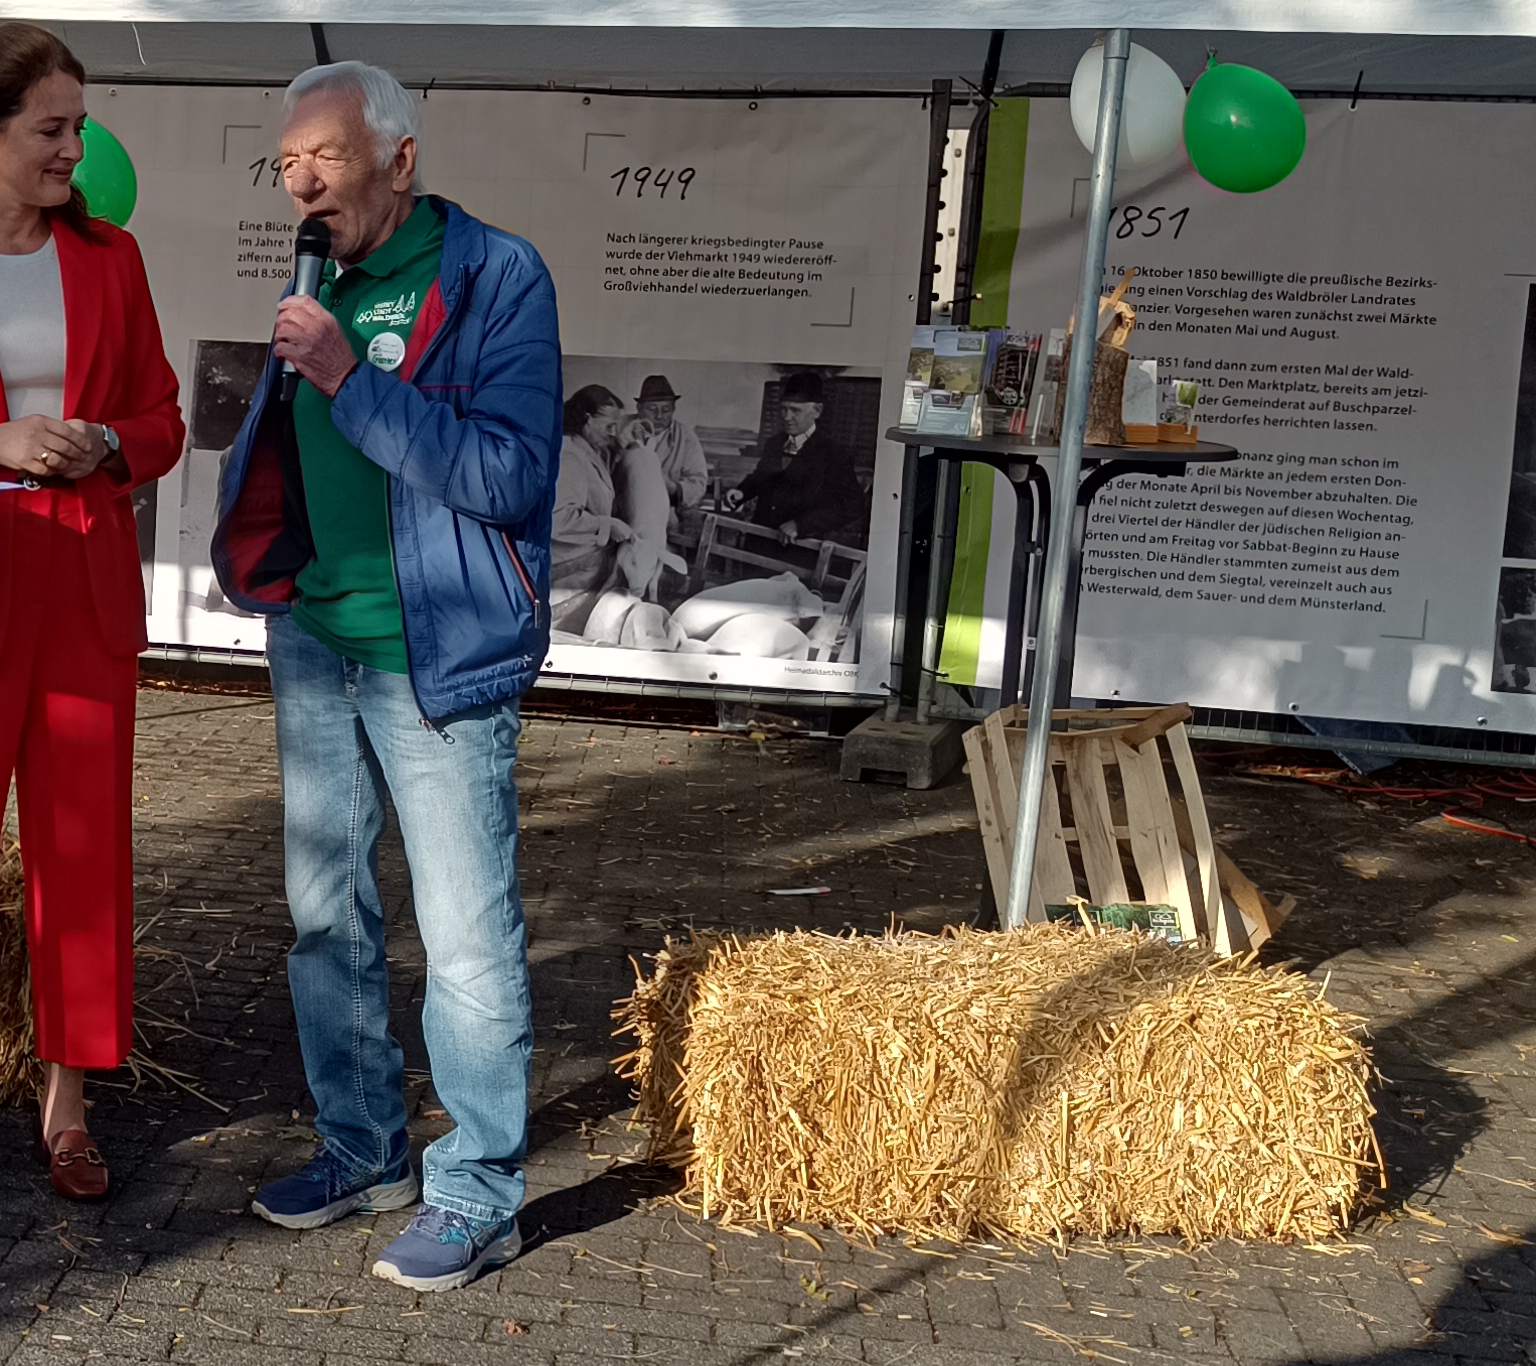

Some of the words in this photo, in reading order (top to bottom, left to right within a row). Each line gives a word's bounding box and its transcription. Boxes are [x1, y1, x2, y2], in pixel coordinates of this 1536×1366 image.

[610, 166, 696, 201] 1949
[238, 221, 263, 232] Eine
[265, 221, 295, 233] Blüte
[254, 236, 285, 248] Jahre
[606, 233, 636, 244] Nach
[638, 233, 689, 248] längerer
[690, 235, 786, 251] kriegsbedingter
[788, 238, 824, 250] Pause
[236, 251, 273, 263] ziffern
[274, 253, 294, 263] auf
[606, 249, 643, 261] wurde
[644, 249, 665, 261] der
[668, 250, 729, 263] Viehmarkt
[732, 252, 761, 264] 1949
[764, 253, 837, 266] wiedereröff-
[236, 267, 259, 278] und
[260, 267, 292, 279] 8.500
[604, 265, 627, 277] net,
[630, 264, 660, 276] ohne
[662, 266, 690, 277] aber
[692, 266, 711, 278] die
[712, 267, 736, 279] alte
[738, 268, 805, 284] Bedeutung
[1188, 268, 1218, 280] 1850
[1220, 269, 1284, 285] bewilligte
[1286, 272, 1307, 284] die
[1310, 274, 1383, 287] preußische
[1386, 276, 1438, 289] Bezirks-
[604, 280, 699, 294] Großviehhandel
[700, 283, 813, 300] wiederzuerlangen.
[1148, 285, 1183, 297] einen
[1186, 286, 1248, 302] Vorschlag
[1251, 288, 1273, 300] des
[1276, 290, 1348, 304] Waldbröler
[1351, 293, 1416, 306] Landrates
[1174, 304, 1249, 318] Vorgesehen
[1252, 309, 1292, 319] waren
[1294, 310, 1353, 322] zunächst
[1356, 312, 1386, 323] zwei
[1390, 313, 1437, 326] Märkte
[1148, 320, 1172, 332] den
[1176, 322, 1232, 335] Monaten
[1234, 324, 1258, 336] Mai
[1261, 326, 1287, 337] und
[1290, 327, 1340, 342] August.
[1184, 357, 1212, 370] fand
[1214, 359, 1247, 371] dann
[1250, 363, 1277, 373] zum
[1280, 364, 1321, 375] ersten
[1324, 365, 1348, 376] Mal
[1352, 366, 1374, 378] der
[1376, 367, 1414, 380] Wald-
[1218, 377, 1243, 389] Den
[1247, 379, 1320, 395] Marktplatz,
[1324, 382, 1368, 395] bereits
[1394, 386, 1428, 400] jetzi-
[1198, 393, 1219, 405] der
[1222, 395, 1305, 410] Gemeinderat
[1308, 400, 1331, 411] auf
[1332, 401, 1417, 417] Buschparzel-
[1264, 415, 1330, 429] herrichten
[1334, 419, 1378, 432] lassen.
[1276, 453, 1305, 467] ging
[1308, 456, 1337, 466] man
[1341, 456, 1379, 468] schon
[1197, 465, 1217, 477] die
[1219, 466, 1265, 480] Märkte
[1286, 470, 1327, 484] jedem
[1330, 475, 1371, 486] ersten
[1374, 476, 1407, 488] Don-
[1116, 478, 1138, 490] der
[1140, 480, 1188, 493] Monate
[1190, 483, 1220, 497] April
[1224, 484, 1242, 497] bis
[1246, 486, 1313, 501] November
[1315, 491, 1392, 506] abzuhalten.
[1396, 495, 1418, 507] Die
[1098, 494, 1118, 506] fiel
[1120, 496, 1151, 508] nicht
[1154, 498, 1197, 511] zuletzt
[1200, 501, 1264, 517] deswegen
[1268, 506, 1290, 517] auf
[1292, 506, 1334, 520] diesen
[1337, 509, 1414, 527] Wochentag,
[1092, 512, 1115, 524] drei
[1118, 514, 1158, 527] Viertel
[1160, 516, 1183, 528] der
[1185, 518, 1236, 532] Händler
[1238, 521, 1260, 533] der
[1262, 523, 1325, 537] jüdischen
[1328, 527, 1382, 542] Religion
[1122, 532, 1146, 543] und
[1172, 534, 1215, 551] Freitag
[1218, 540, 1240, 549] vor
[1242, 539, 1338, 557] Sabbat-Beginn
[1359, 547, 1400, 560] Hause
[1088, 549, 1143, 561] mussten.
[1146, 551, 1168, 562] Die
[1170, 552, 1221, 566] Händler
[1223, 557, 1288, 571] stammten
[1291, 562, 1342, 574] zumeist
[1345, 566, 1368, 576] aus
[1370, 565, 1400, 578] dem
[1160, 570, 1185, 581] und
[1188, 571, 1216, 583] dem
[1219, 573, 1266, 589] Siegtal,
[1269, 578, 1333, 592] vereinzelt
[1336, 582, 1367, 594] auch
[1370, 586, 1393, 596] aus
[1087, 582, 1162, 599] Westerwald,
[1165, 587, 1193, 600] dem
[1196, 589, 1238, 603] Sauer-
[1240, 593, 1264, 604] und
[1268, 594, 1297, 607] dem
[1300, 596, 1386, 613] Münsterland.
